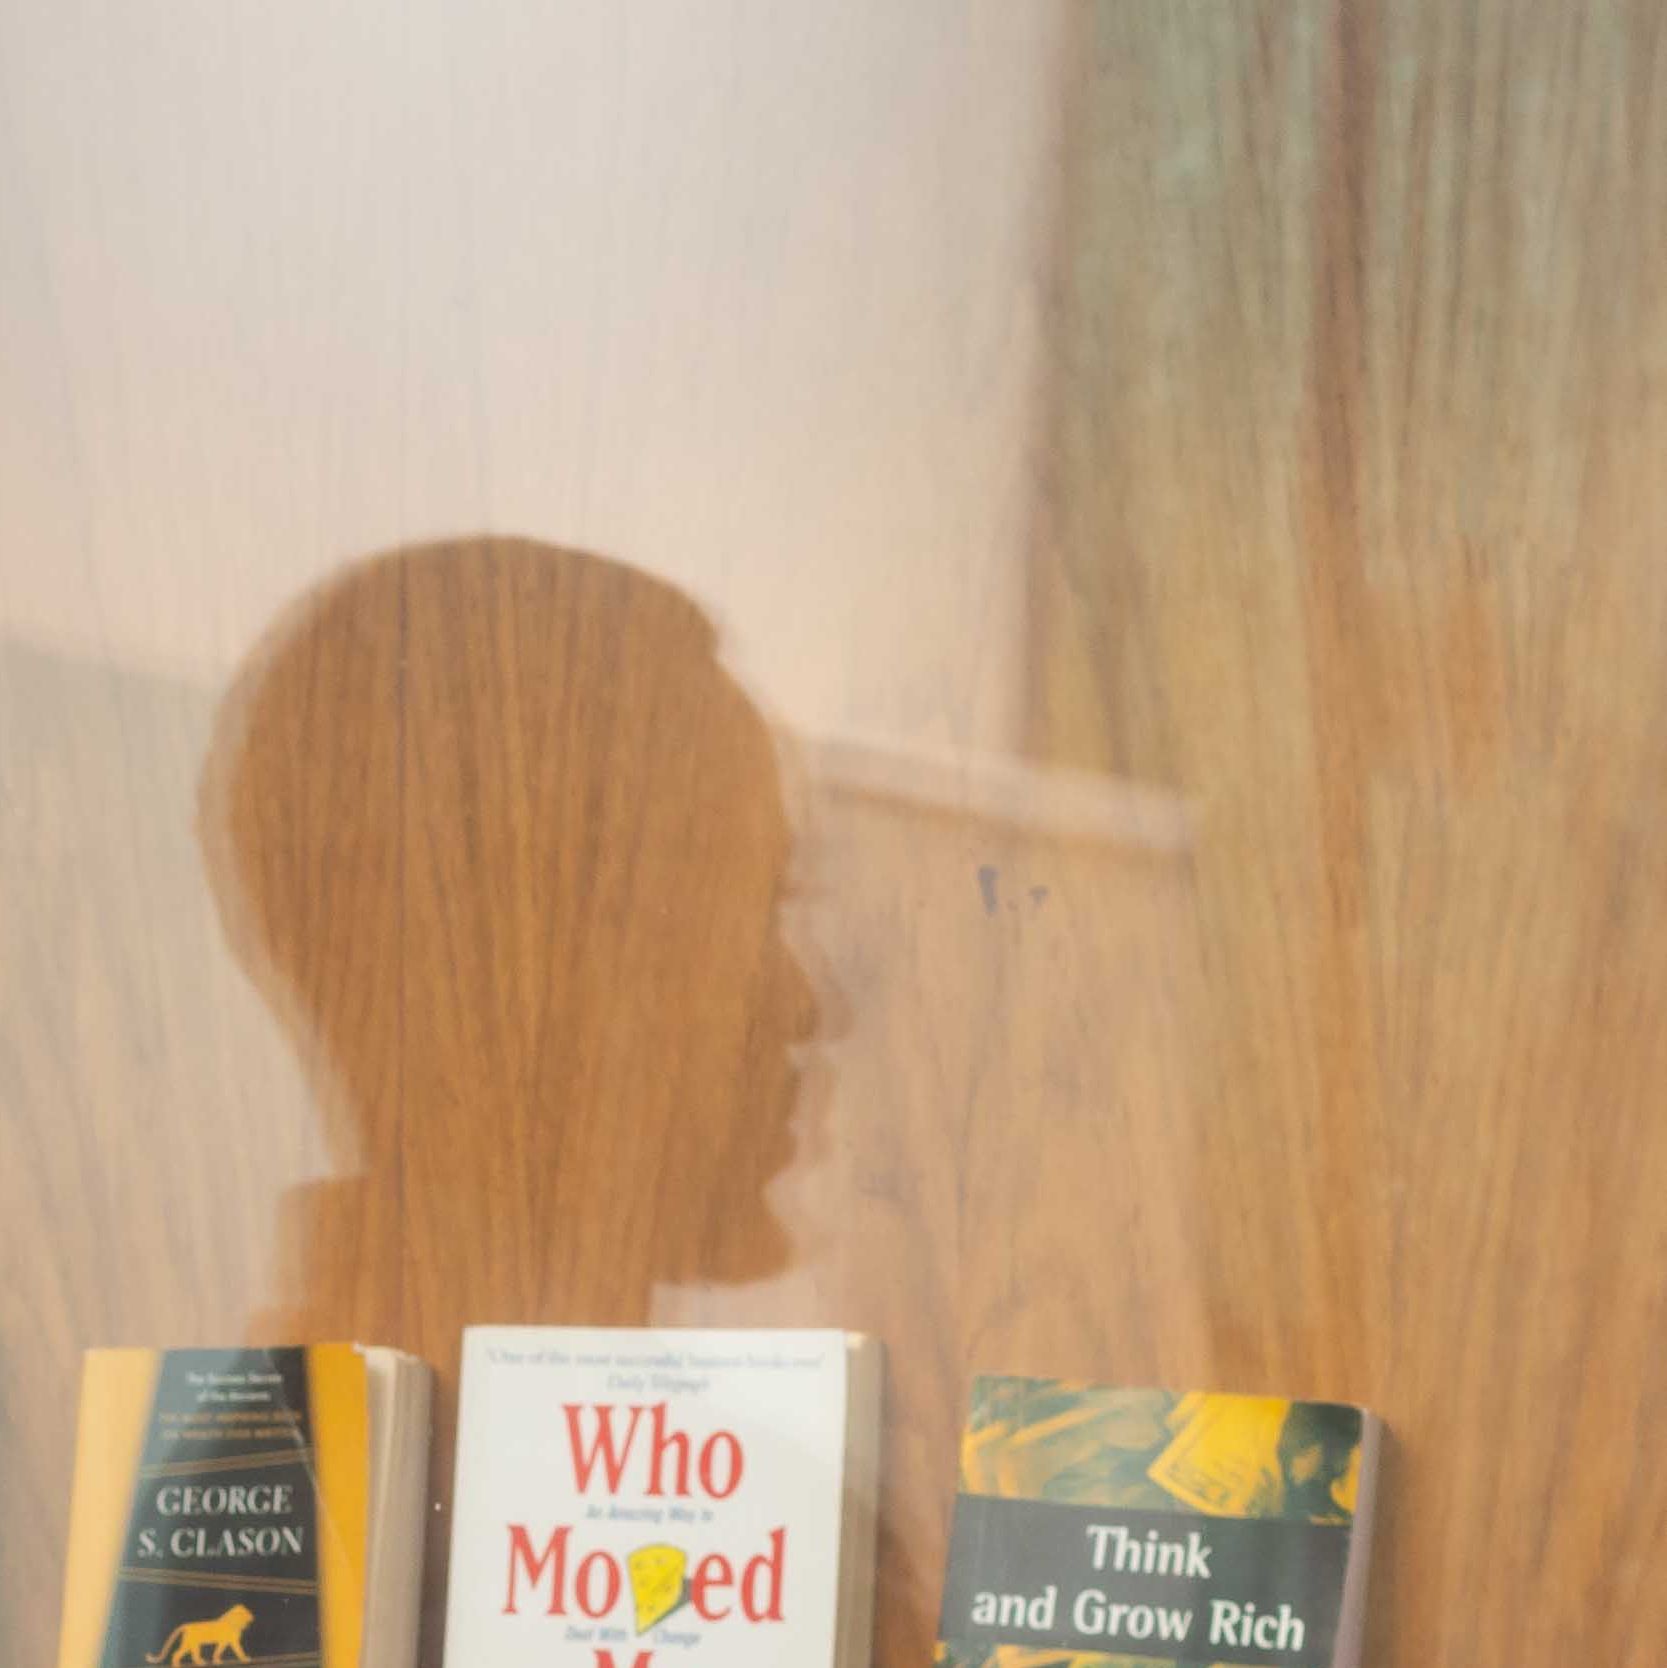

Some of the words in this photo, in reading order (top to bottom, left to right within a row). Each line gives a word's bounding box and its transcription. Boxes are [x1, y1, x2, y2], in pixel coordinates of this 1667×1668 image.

[561, 1402, 744, 1499] Who
[156, 1485, 292, 1516] GEORGE
[138, 1528, 164, 1558] S.
[170, 1527, 303, 1558] CLASON
[1086, 1524, 1211, 1579] Think
[502, 1524, 788, 1622] Moed
[971, 1585, 1057, 1630] and
[1072, 1589, 1192, 1642] Grow
[1209, 1598, 1305, 1651] Rich
